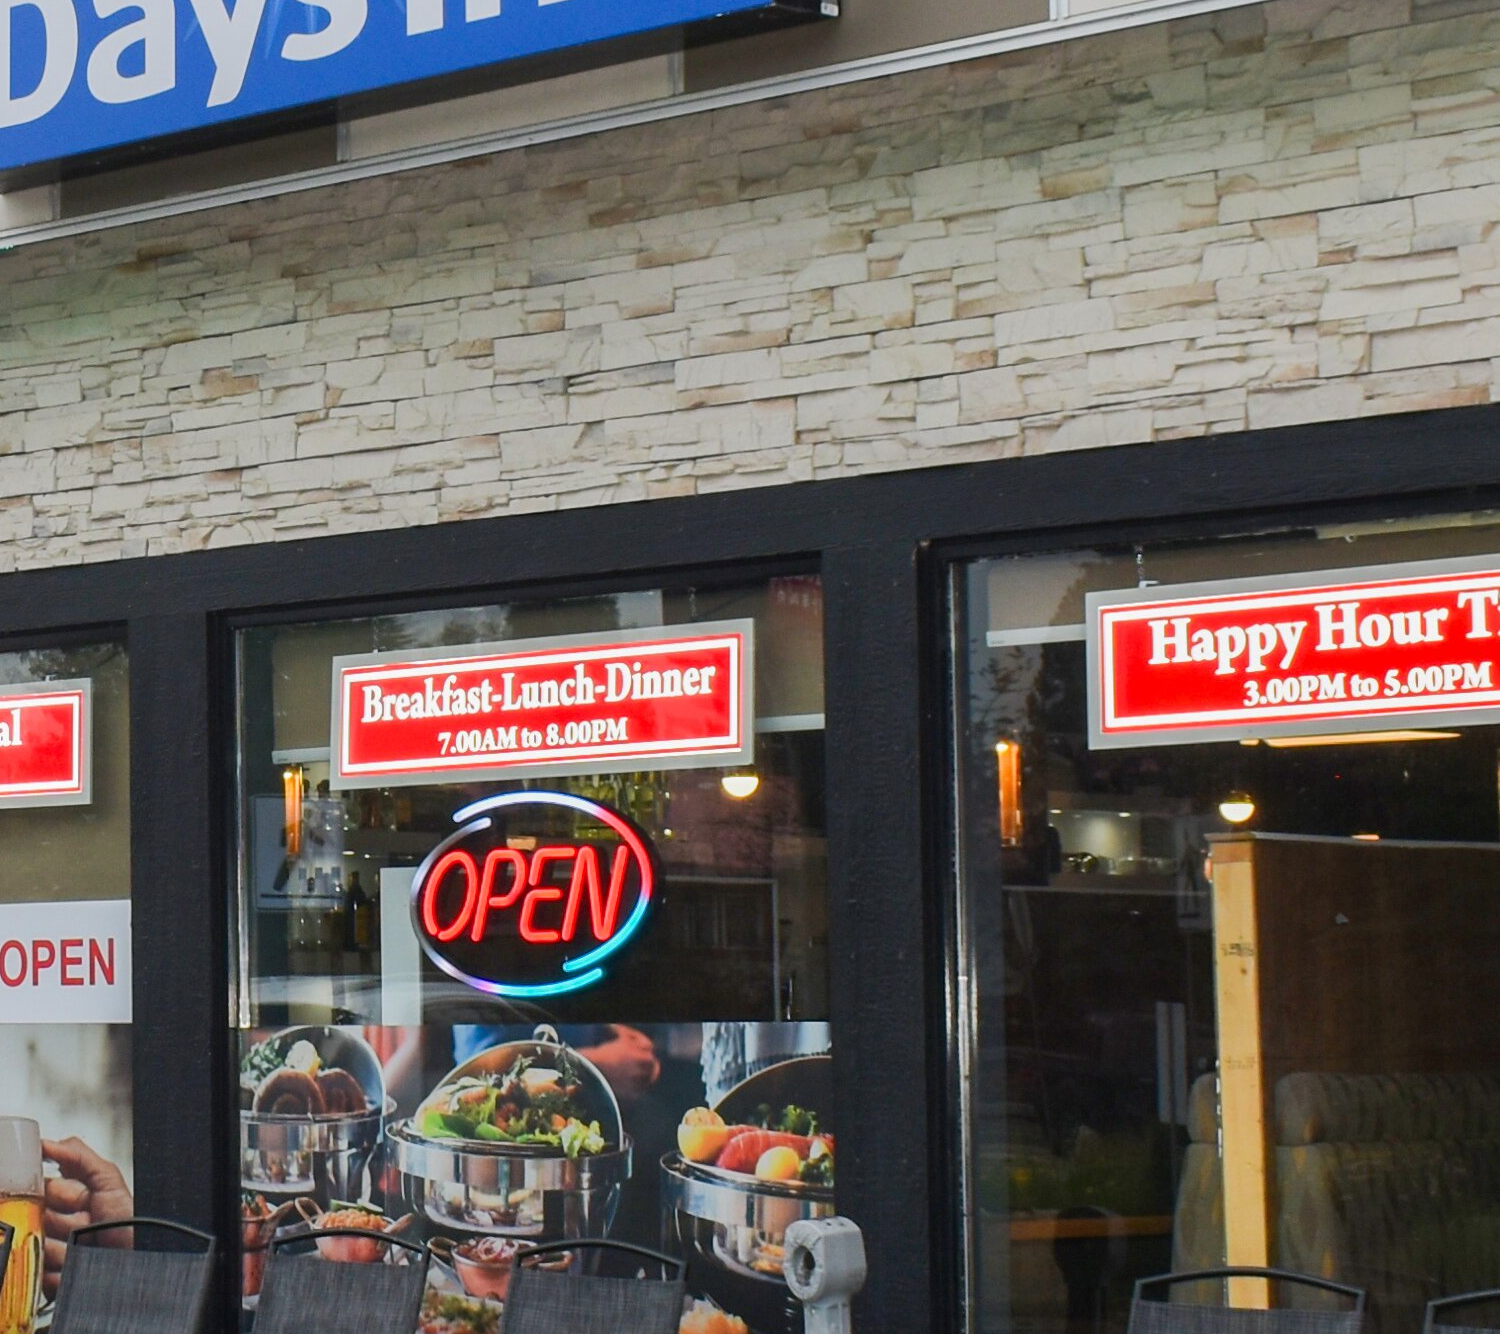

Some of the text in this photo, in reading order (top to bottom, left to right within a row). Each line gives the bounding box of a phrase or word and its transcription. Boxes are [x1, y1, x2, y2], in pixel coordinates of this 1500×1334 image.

[1147, 613, 1307, 675] Happy
[1314, 602, 1449, 652] Hour
[361, 662, 716, 724] Breakfast-Lunch-Dinner
[1242, 661, 1493, 708] 3.00PM to 5.00PM
[437, 717, 628, 756] 7.00AM to 8.00PM
[421, 844, 629, 944] OPEN
[0, 936, 117, 988] OPEN
